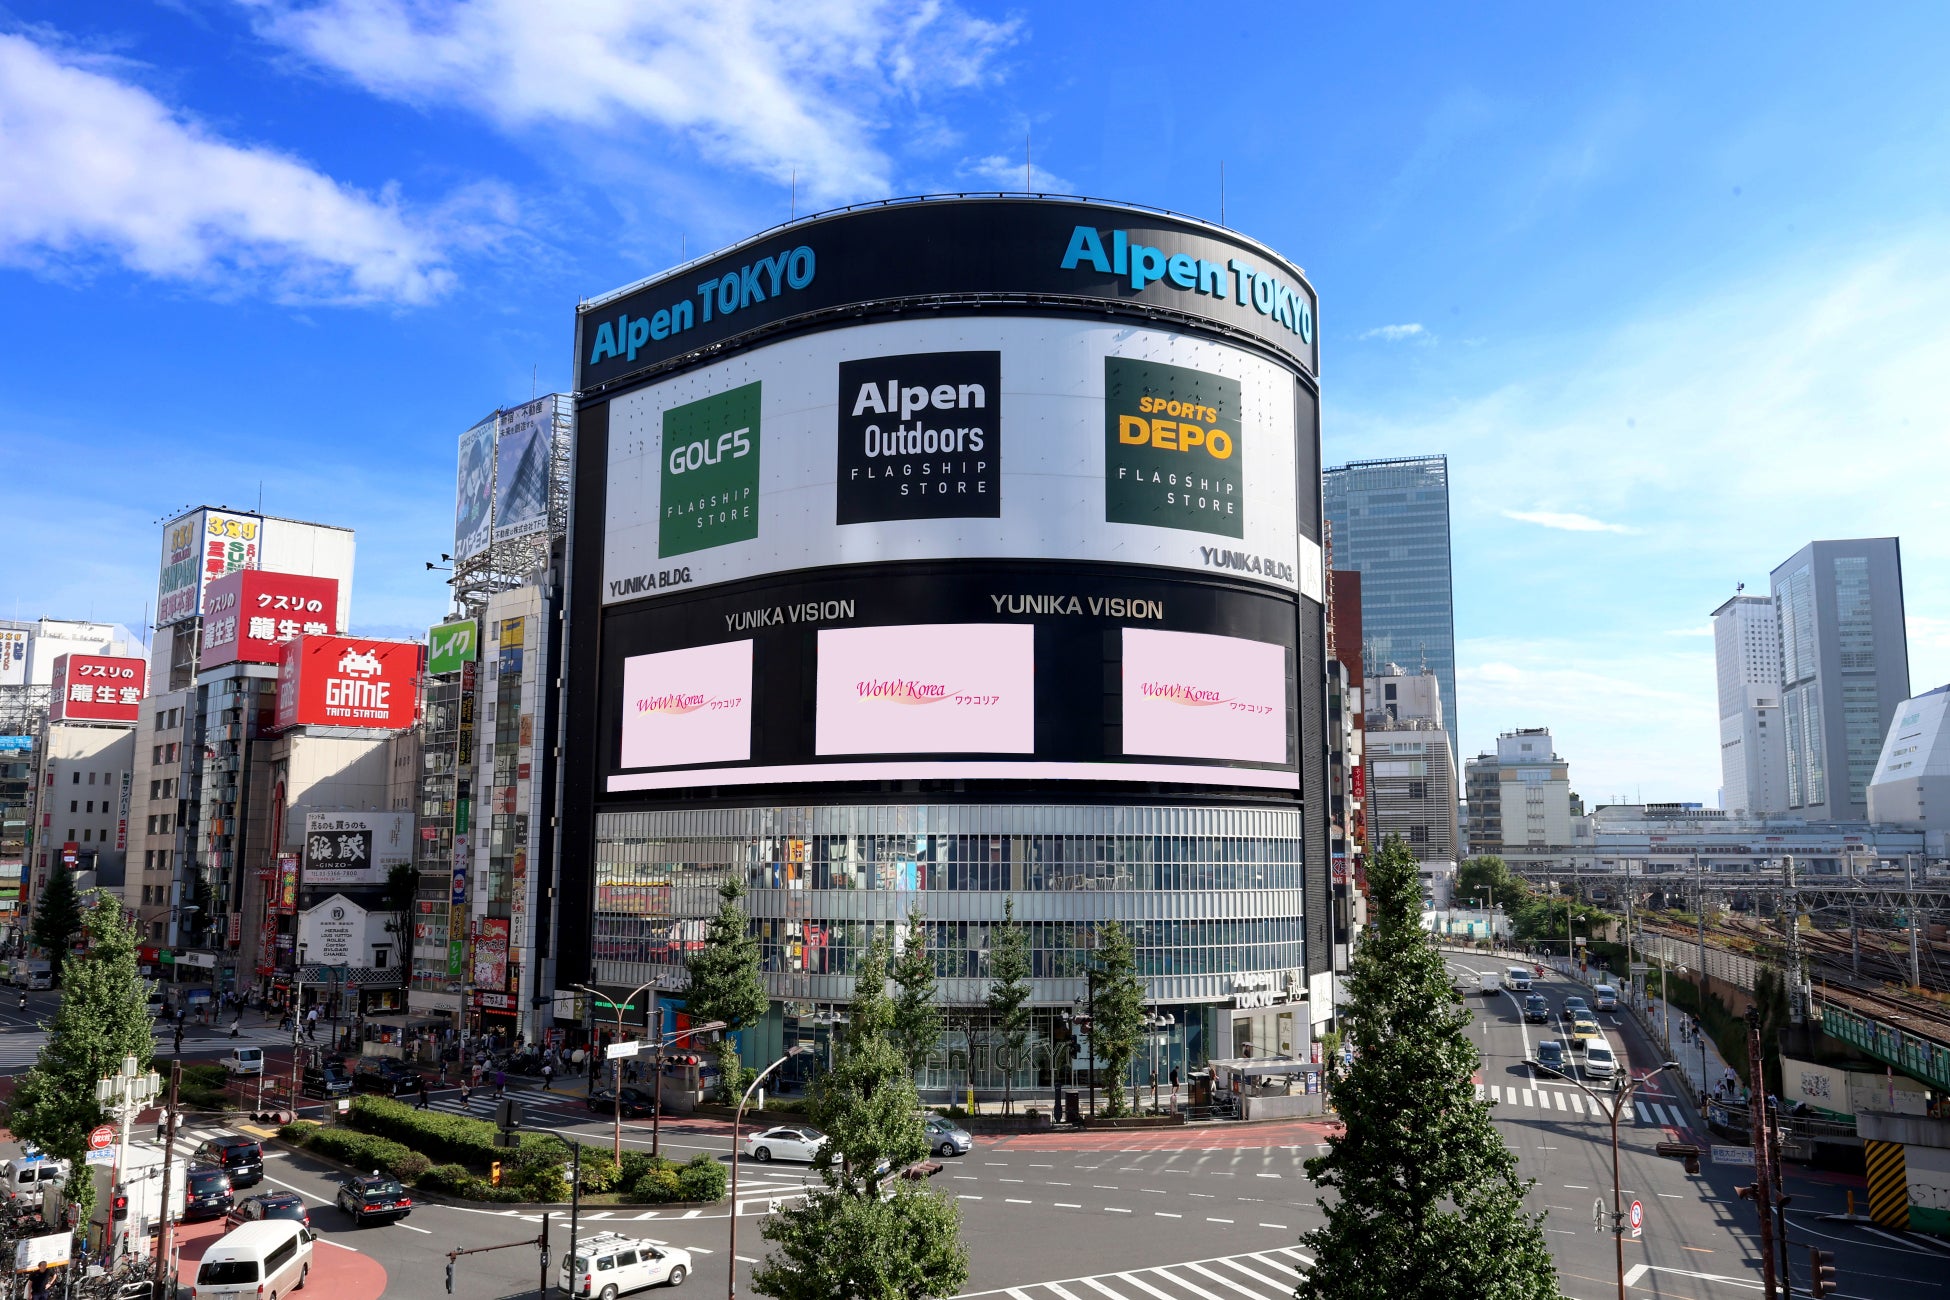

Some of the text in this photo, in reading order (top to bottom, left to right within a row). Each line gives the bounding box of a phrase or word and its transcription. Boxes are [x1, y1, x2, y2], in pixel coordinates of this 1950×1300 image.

[1060, 225, 1313, 345] Alpen TOKYO
[590, 245, 817, 366] Alpen TOKYO
[851, 379, 986, 421] Alpen
[1139, 396, 1217, 424] SPORTS
[864, 421, 984, 458] Outdoors
[1119, 414, 1233, 460] DEPO
[669, 427, 751, 475] GOLF5
[851, 461, 987, 481] FLAGSHIP
[1119, 467, 1234, 495] FLAGSHIP
[900, 481, 987, 496] STORE
[667, 487, 751, 518] FLAGSHIP
[1167, 492, 1234, 515] STORE
[697, 506, 750, 529] STORE
[1200, 545, 1294, 583] YUNIKA BLDG.
[609, 566, 693, 597] YUNIKA BLDG.
[208, 592, 236, 615] クスリの
[257, 593, 323, 613] クスリの
[990, 594, 1163, 620] YUNIKA VISION
[725, 599, 855, 632] YUNIKA VISION
[249, 616, 328, 642] 龍生堂
[431, 630, 471, 660] レイク
[79, 664, 135, 679] クスリの
[69, 684, 141, 705] 龍生堂
[325, 678, 391, 709] GAME
[856, 678, 946, 700] WoW! Korea
[955, 695, 1000, 706] ワウコリア
[1183, 685, 1221, 703] Korea
[675, 692, 704, 710] Korea
[710, 697, 742, 710] ワウコリア
[1229, 701, 1273, 715] ワウコリア
[325, 707, 389, 720] TAITO STATION
[1354, 768, 1362, 788] ネイル
[451, 946, 459, 969] レイク
[1233, 971, 1275, 991] Alpen
[1233, 990, 1275, 1009] TOKYO
